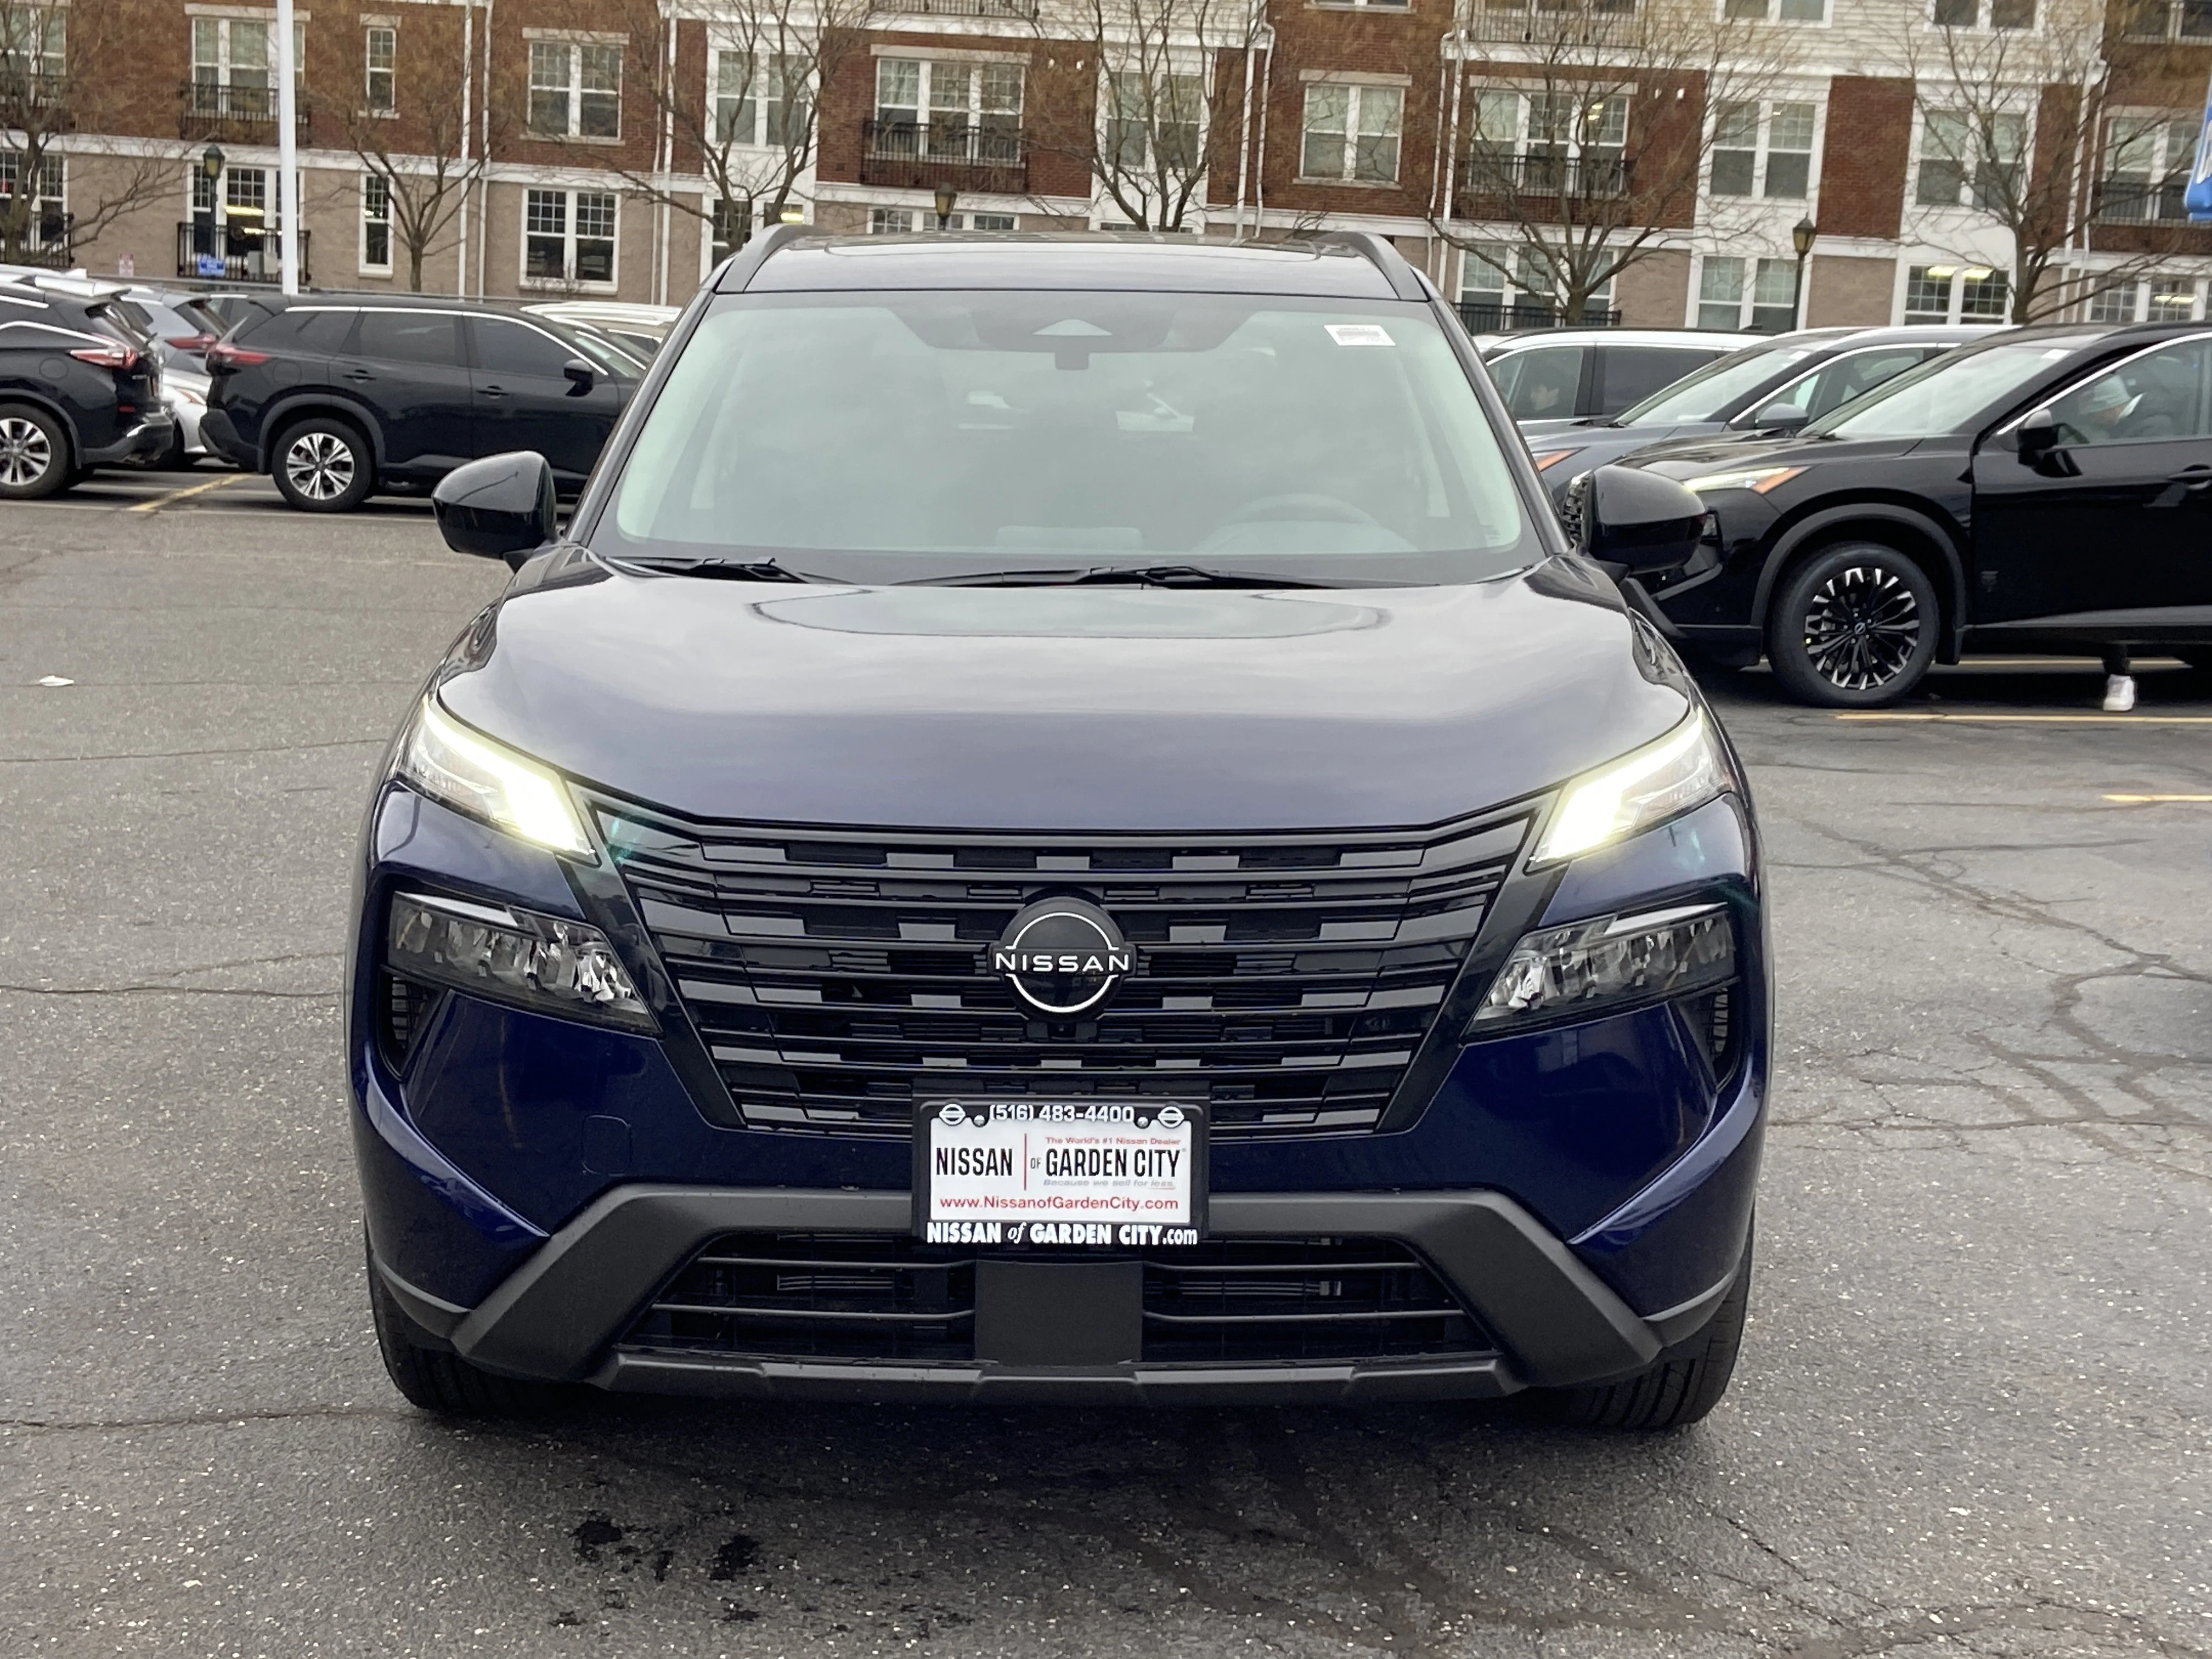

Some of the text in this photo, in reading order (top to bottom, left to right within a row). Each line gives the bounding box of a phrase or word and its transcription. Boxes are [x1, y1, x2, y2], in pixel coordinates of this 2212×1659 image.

[995, 952, 1129, 972] NISSAN
[990, 1104, 1135, 1122] (516) 483-4400
[936, 1148, 1180, 1177] NISSAN OF GARDEN CITY
[940, 1195, 1178, 1211] www.NissanofGardenCity.com
[927, 1222, 1198, 1245] NISSAN of GARDEN CITY.com
